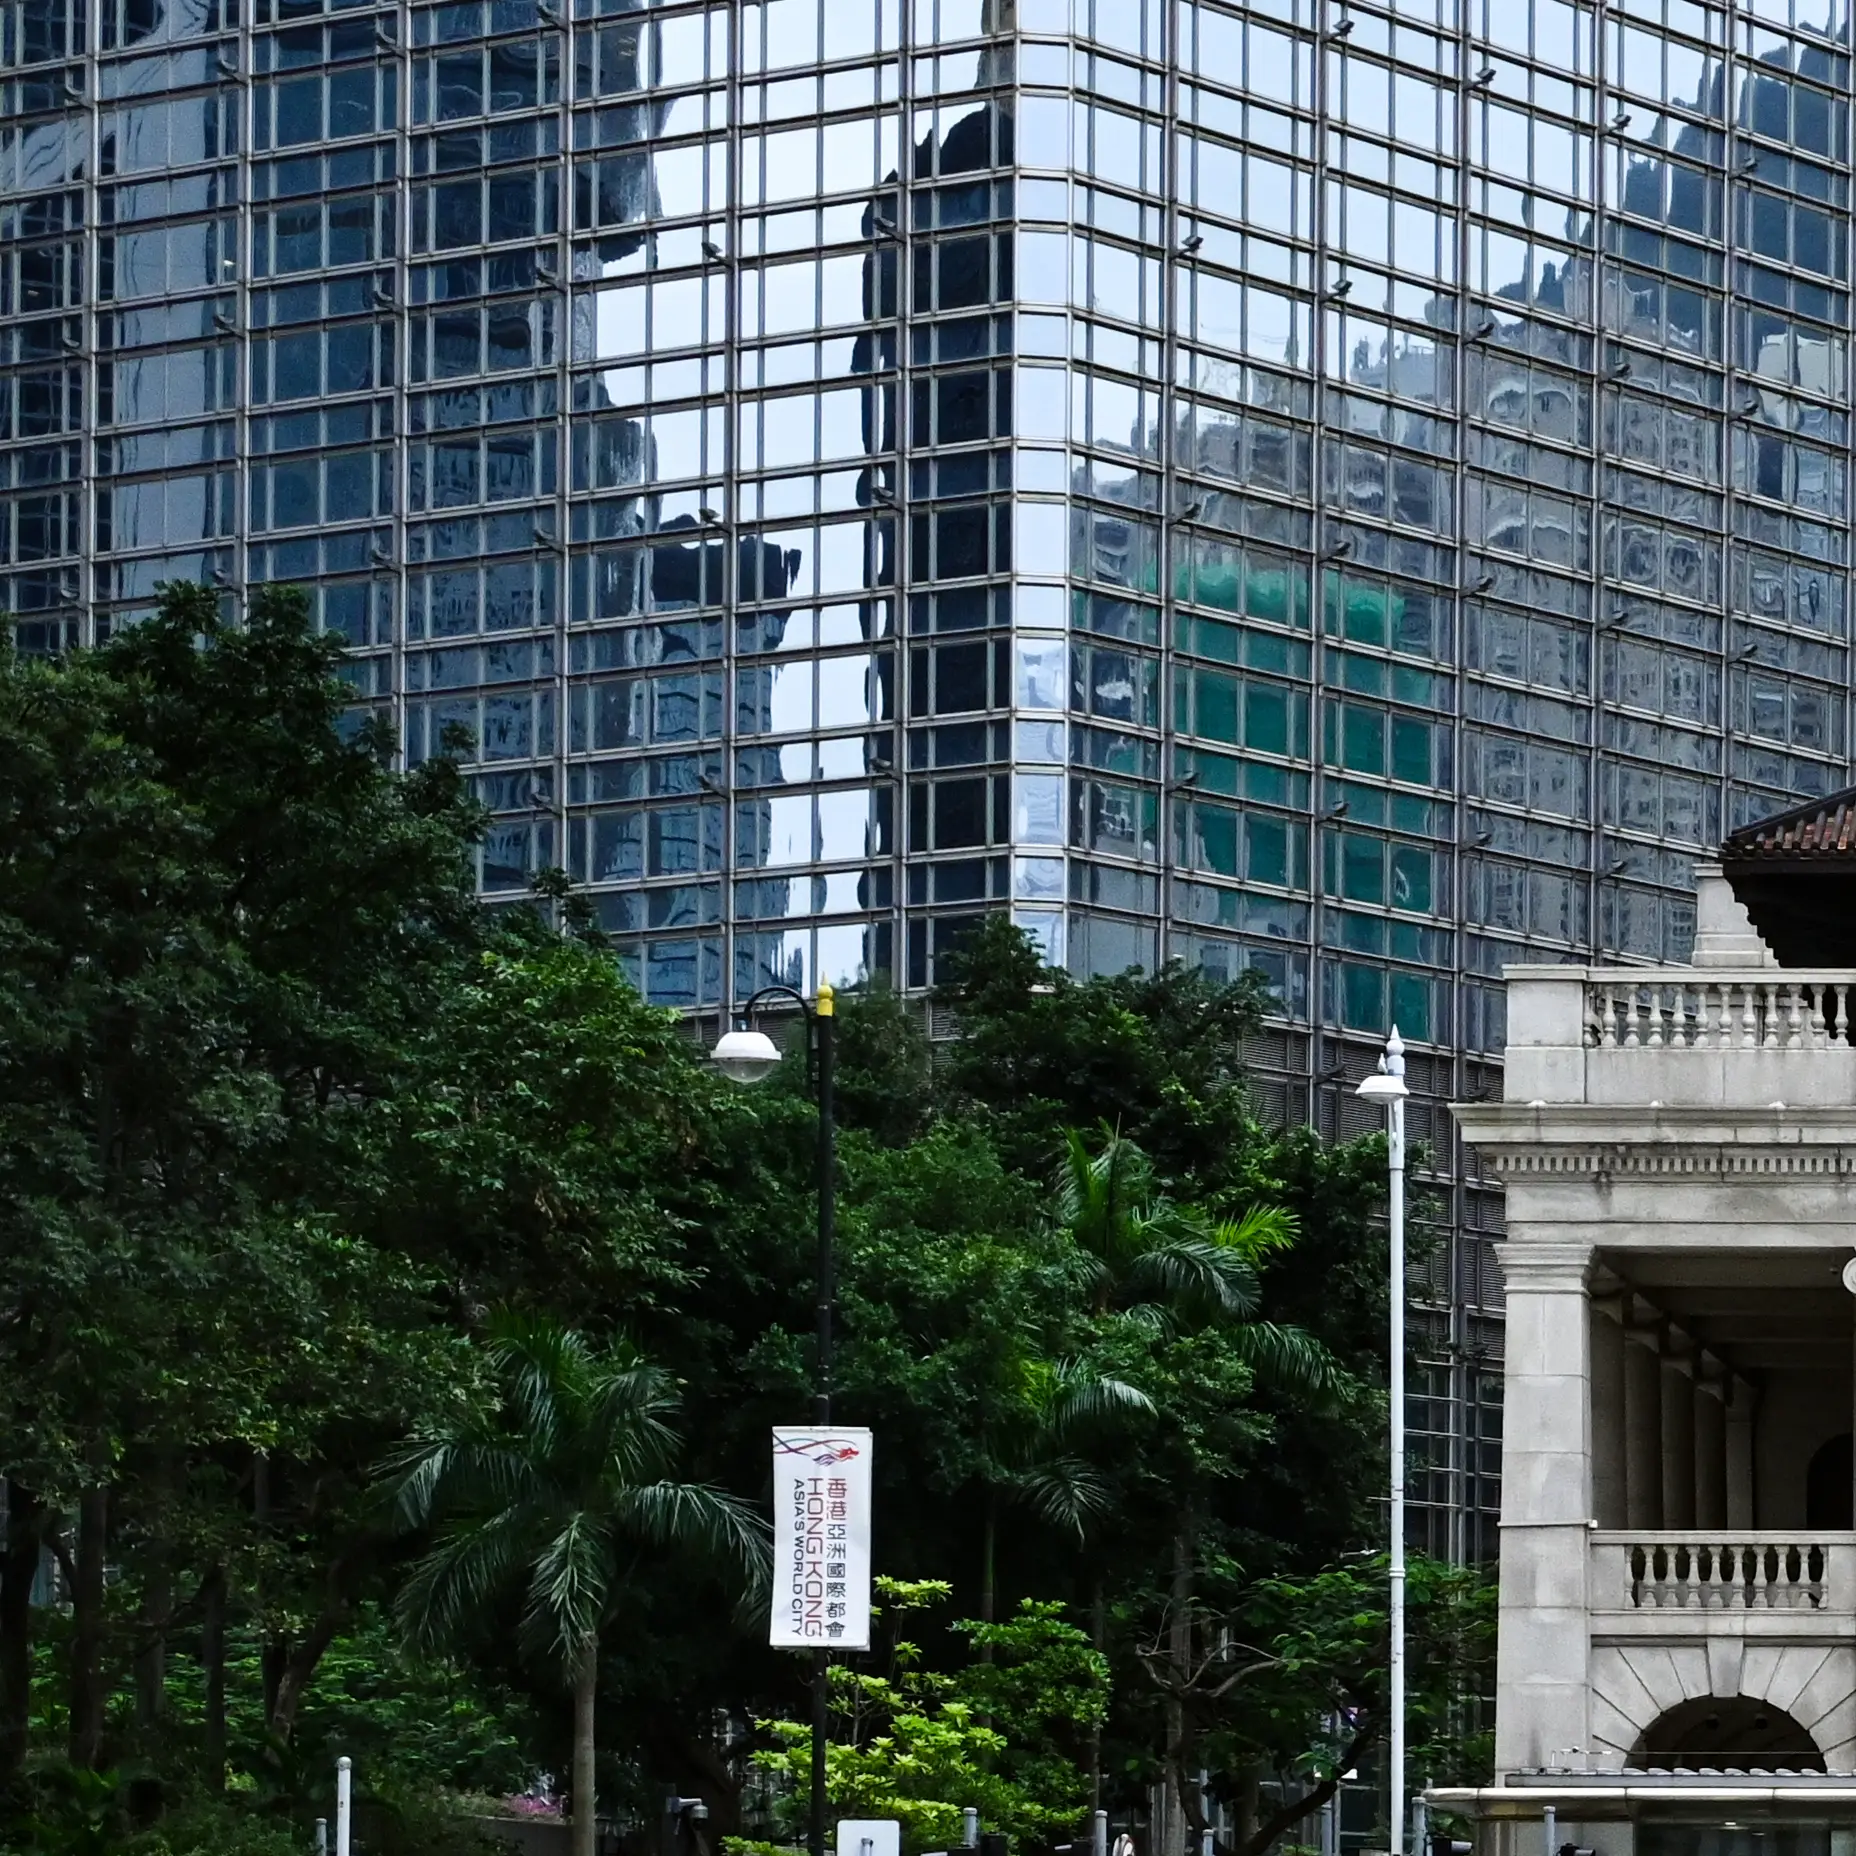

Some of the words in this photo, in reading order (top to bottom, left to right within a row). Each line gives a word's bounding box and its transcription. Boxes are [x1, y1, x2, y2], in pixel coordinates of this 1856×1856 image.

[793, 1479, 805, 1532] ASIA'S
[806, 1478, 824, 1556] HONG
[792, 1535, 805, 1594] WORLD
[825, 1478, 847, 1638] 香港亞洲國際都會
[791, 1598, 803, 1637] CITY
[805, 1561, 823, 1638] KONG
